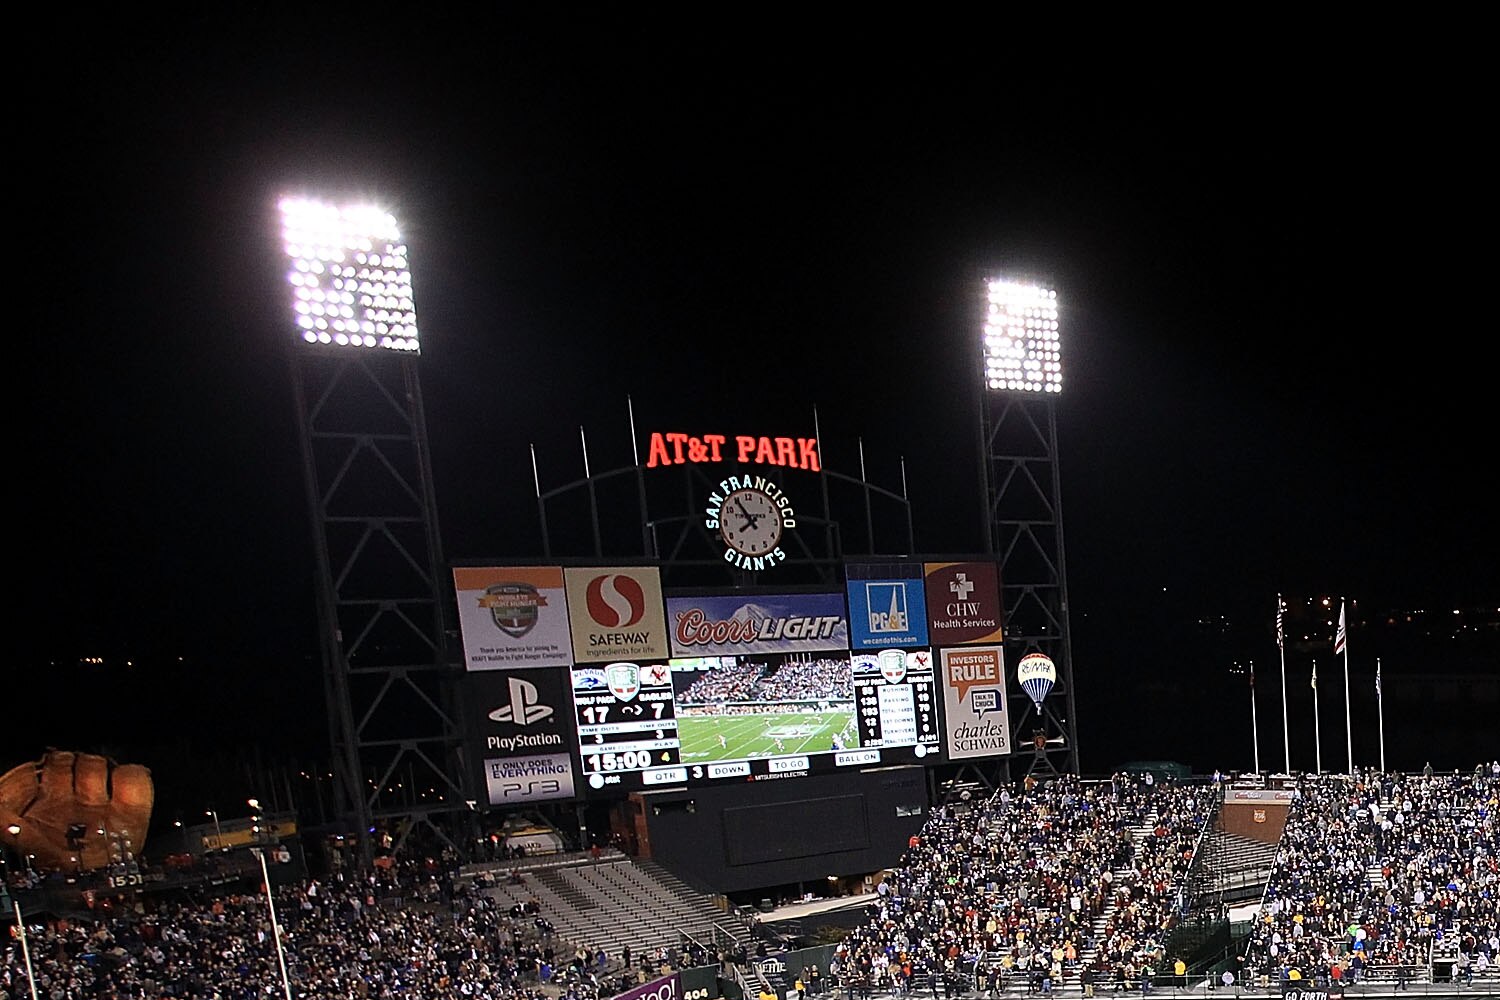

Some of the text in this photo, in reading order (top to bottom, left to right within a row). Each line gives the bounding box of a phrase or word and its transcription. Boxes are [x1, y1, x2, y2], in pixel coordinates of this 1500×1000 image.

[647, 432, 822, 472] AT&T PARK
[706, 474, 796, 529] SAN FRANCISCO
[724, 546, 786, 571] GIANTS
[946, 602, 981, 617] CHW
[676, 608, 839, 646] Coors LIGHT
[872, 611, 907, 631] PG&E
[933, 618, 996, 629] Health Services
[589, 631, 650, 647] SAFEWAY
[950, 655, 994, 664] INVESTORS
[951, 664, 996, 682] RULE
[1021, 661, 1052, 676] RE/MAX
[650, 702, 665, 719] 7
[975, 700, 994, 708] CHUCK
[582, 706, 610, 724] 17
[655, 729, 664, 739] 3
[954, 720, 1003, 739] charles
[487, 733, 561, 752] PlayStation
[595, 734, 604, 744] 3
[954, 737, 1006, 752] SCHWAB
[588, 750, 652, 772] 15:00
[661, 751, 671, 762] 4
[838, 753, 877, 763] BALL ON
[491, 758, 553, 771] IT ONLY DOES
[692, 765, 703, 779] 3
[714, 765, 745, 775] DOWN
[774, 759, 804, 770] TO GO
[655, 771, 676, 781] QTR
[503, 780, 560, 797] PS3
[684, 988, 708, 1000] 404
